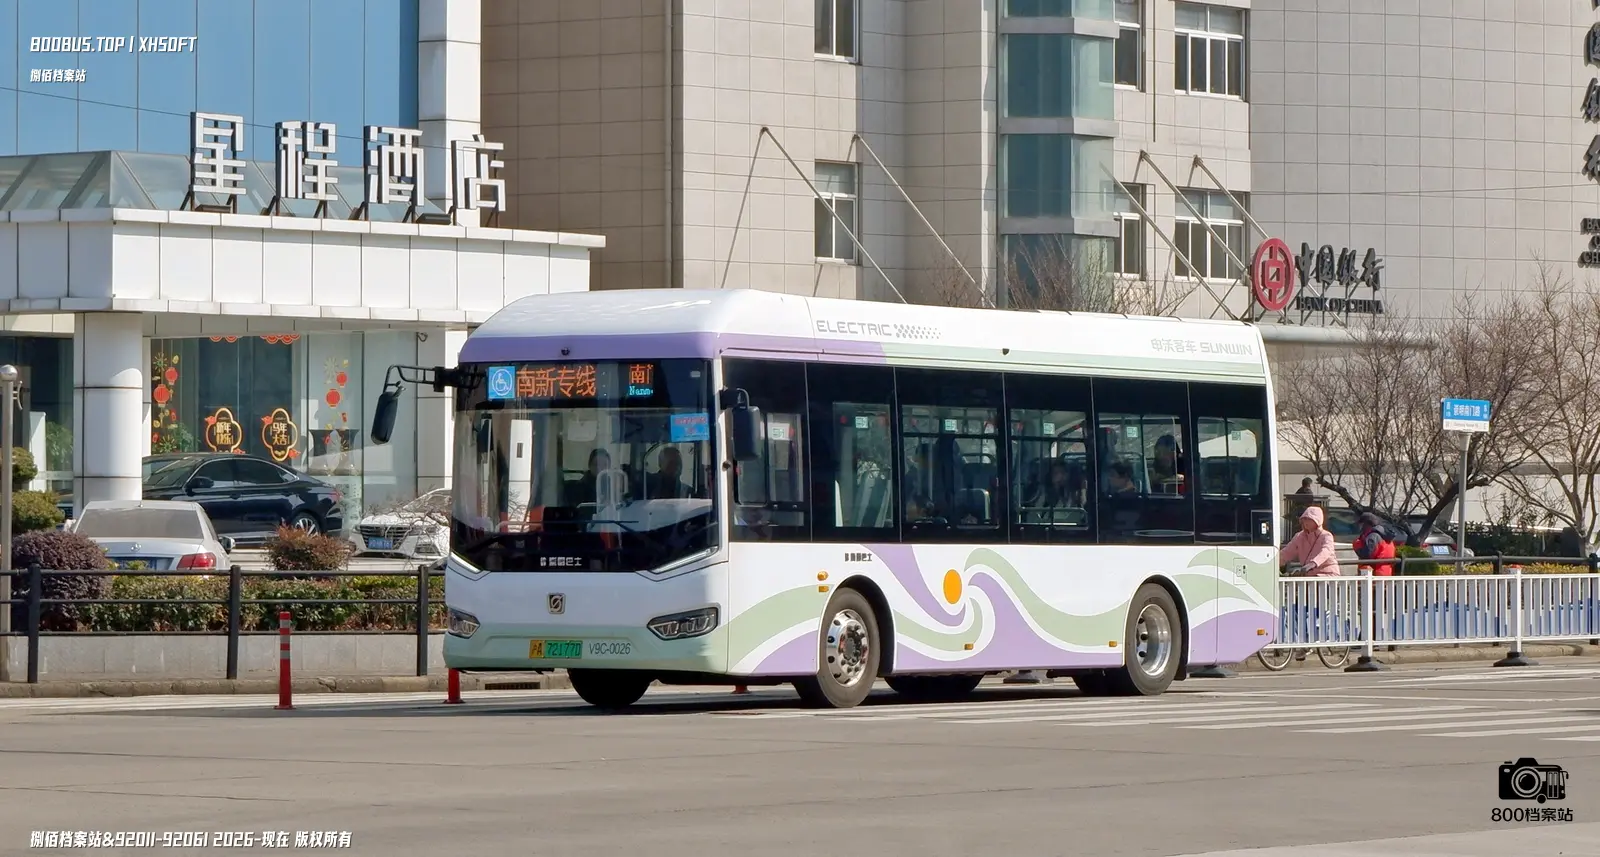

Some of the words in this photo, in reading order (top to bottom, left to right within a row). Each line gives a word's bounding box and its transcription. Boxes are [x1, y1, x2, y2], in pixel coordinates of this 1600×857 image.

[190, 111, 506, 212] 星程酒店
[1295, 242, 1384, 291] 中国银行
[1297, 296, 1328, 312] BANK
[1346, 299, 1384, 314] CHINA
[816, 320, 892, 336] ELECTRIC
[1150, 338, 1197, 353] 申沃客车
[1199, 341, 1253, 356] SUNWIN
[516, 365, 597, 398] 南新专线
[589, 642, 632, 655] V9C-0026
